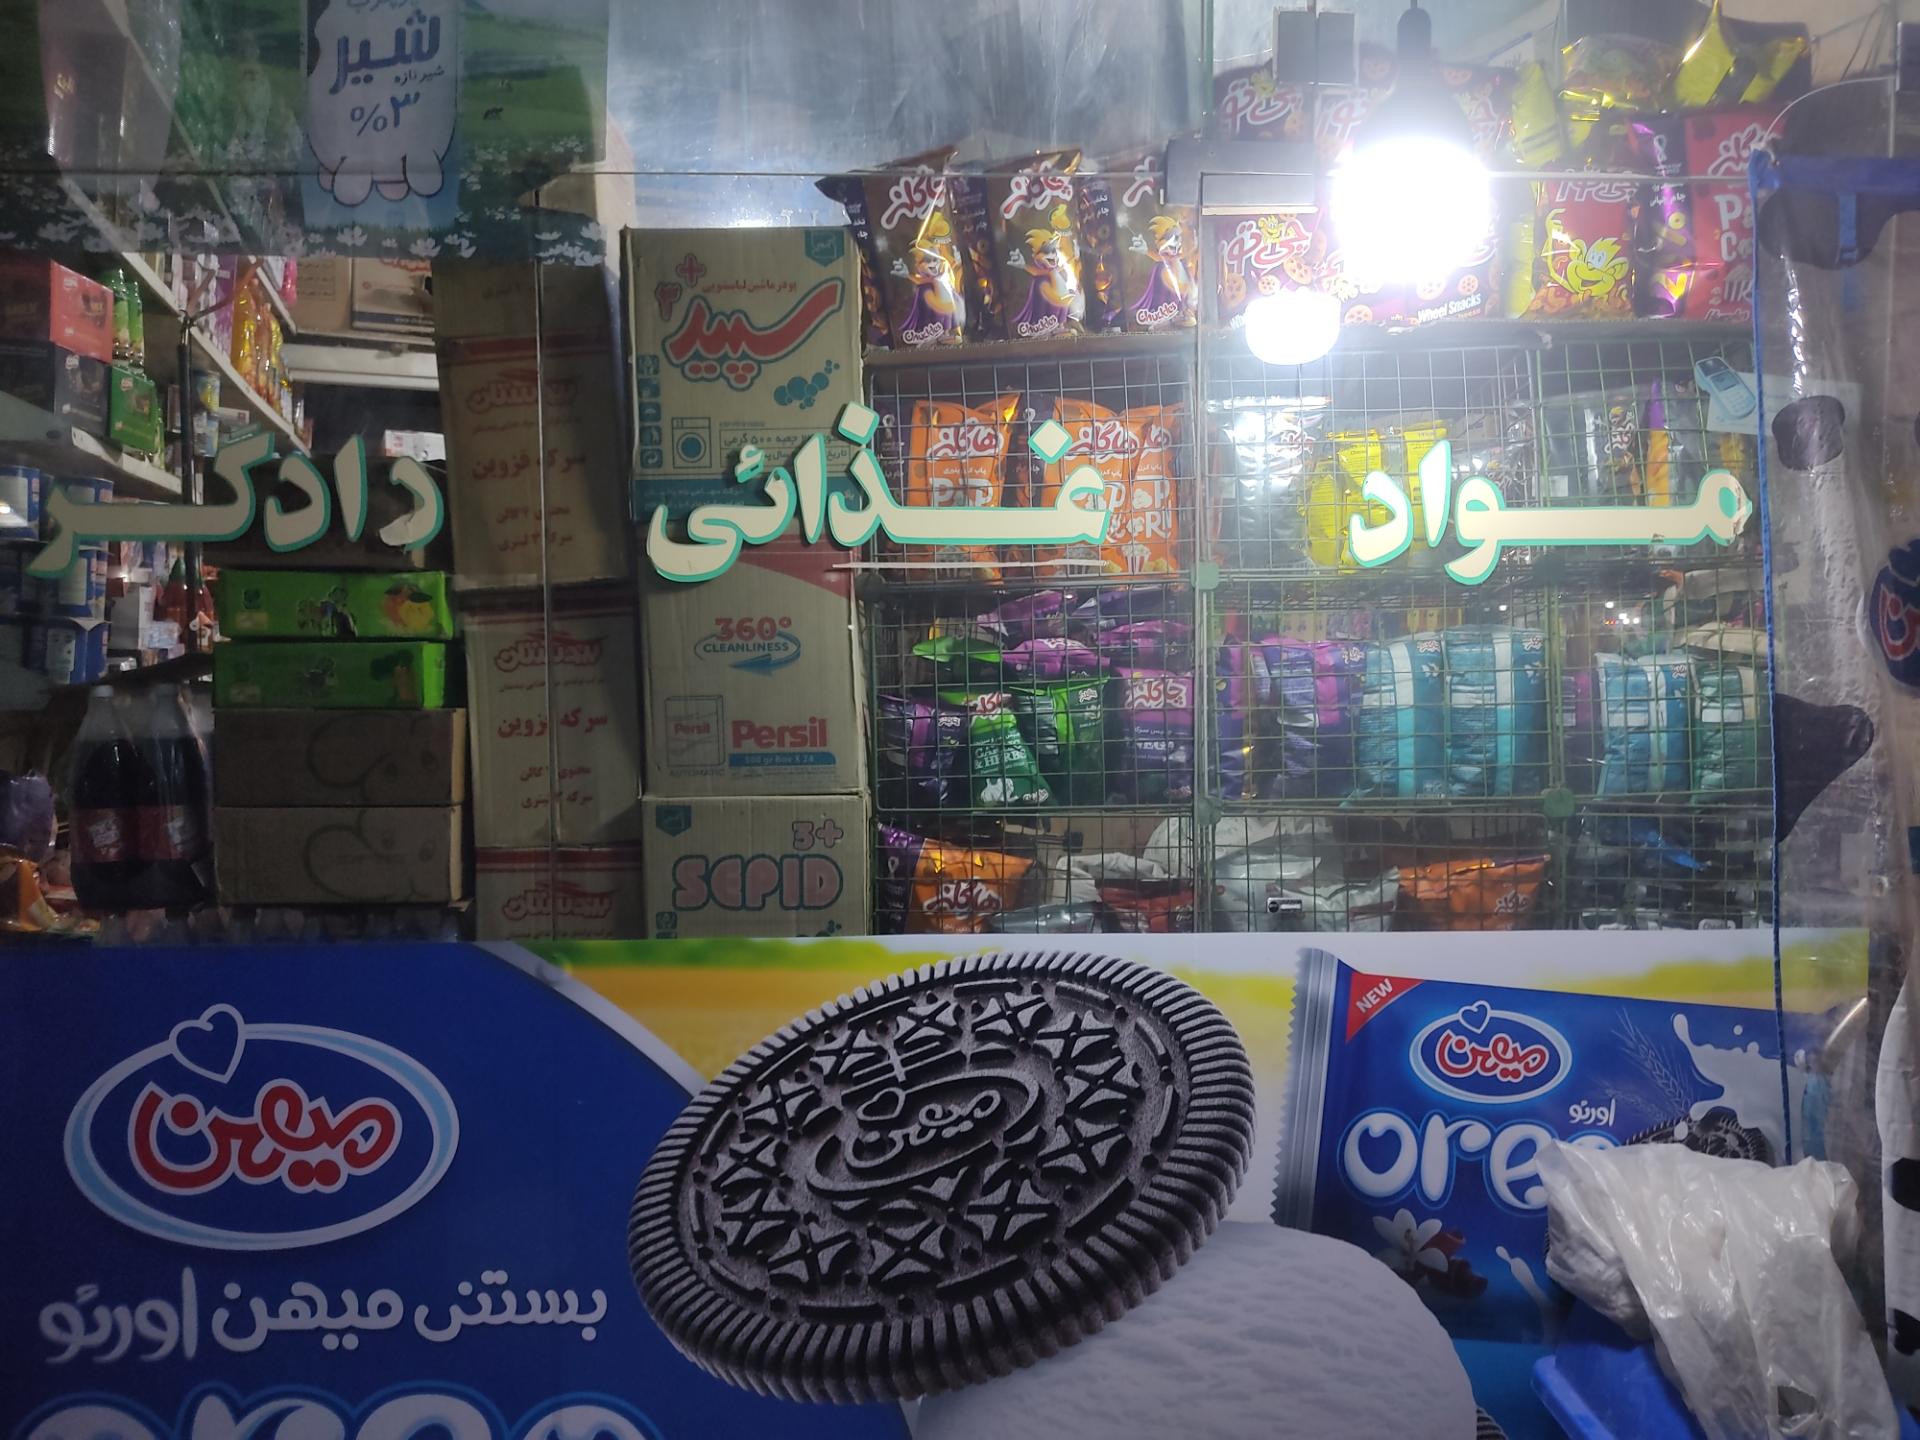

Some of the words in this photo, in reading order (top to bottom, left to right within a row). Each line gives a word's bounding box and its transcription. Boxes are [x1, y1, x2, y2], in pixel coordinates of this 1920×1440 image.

[329, 9, 442, 95] شیر
[662, 276, 846, 391] سپید
[1136, 301, 1180, 327] Chuckles
[25, 423, 445, 578] دادگر
[646, 402, 1112, 583] غذائی
[1348, 438, 1754, 585] مواد
[703, 641, 790, 654] CLEANLINESS
[731, 715, 828, 749] Persil
[671, 853, 844, 912] SEPID
[1353, 976, 1395, 1016] NEW
[1434, 1026, 1549, 1082] میهن
[127, 1078, 403, 1195] میهن
[211, 1280, 404, 1353] میهن
[414, 1269, 608, 1342] بستنی
